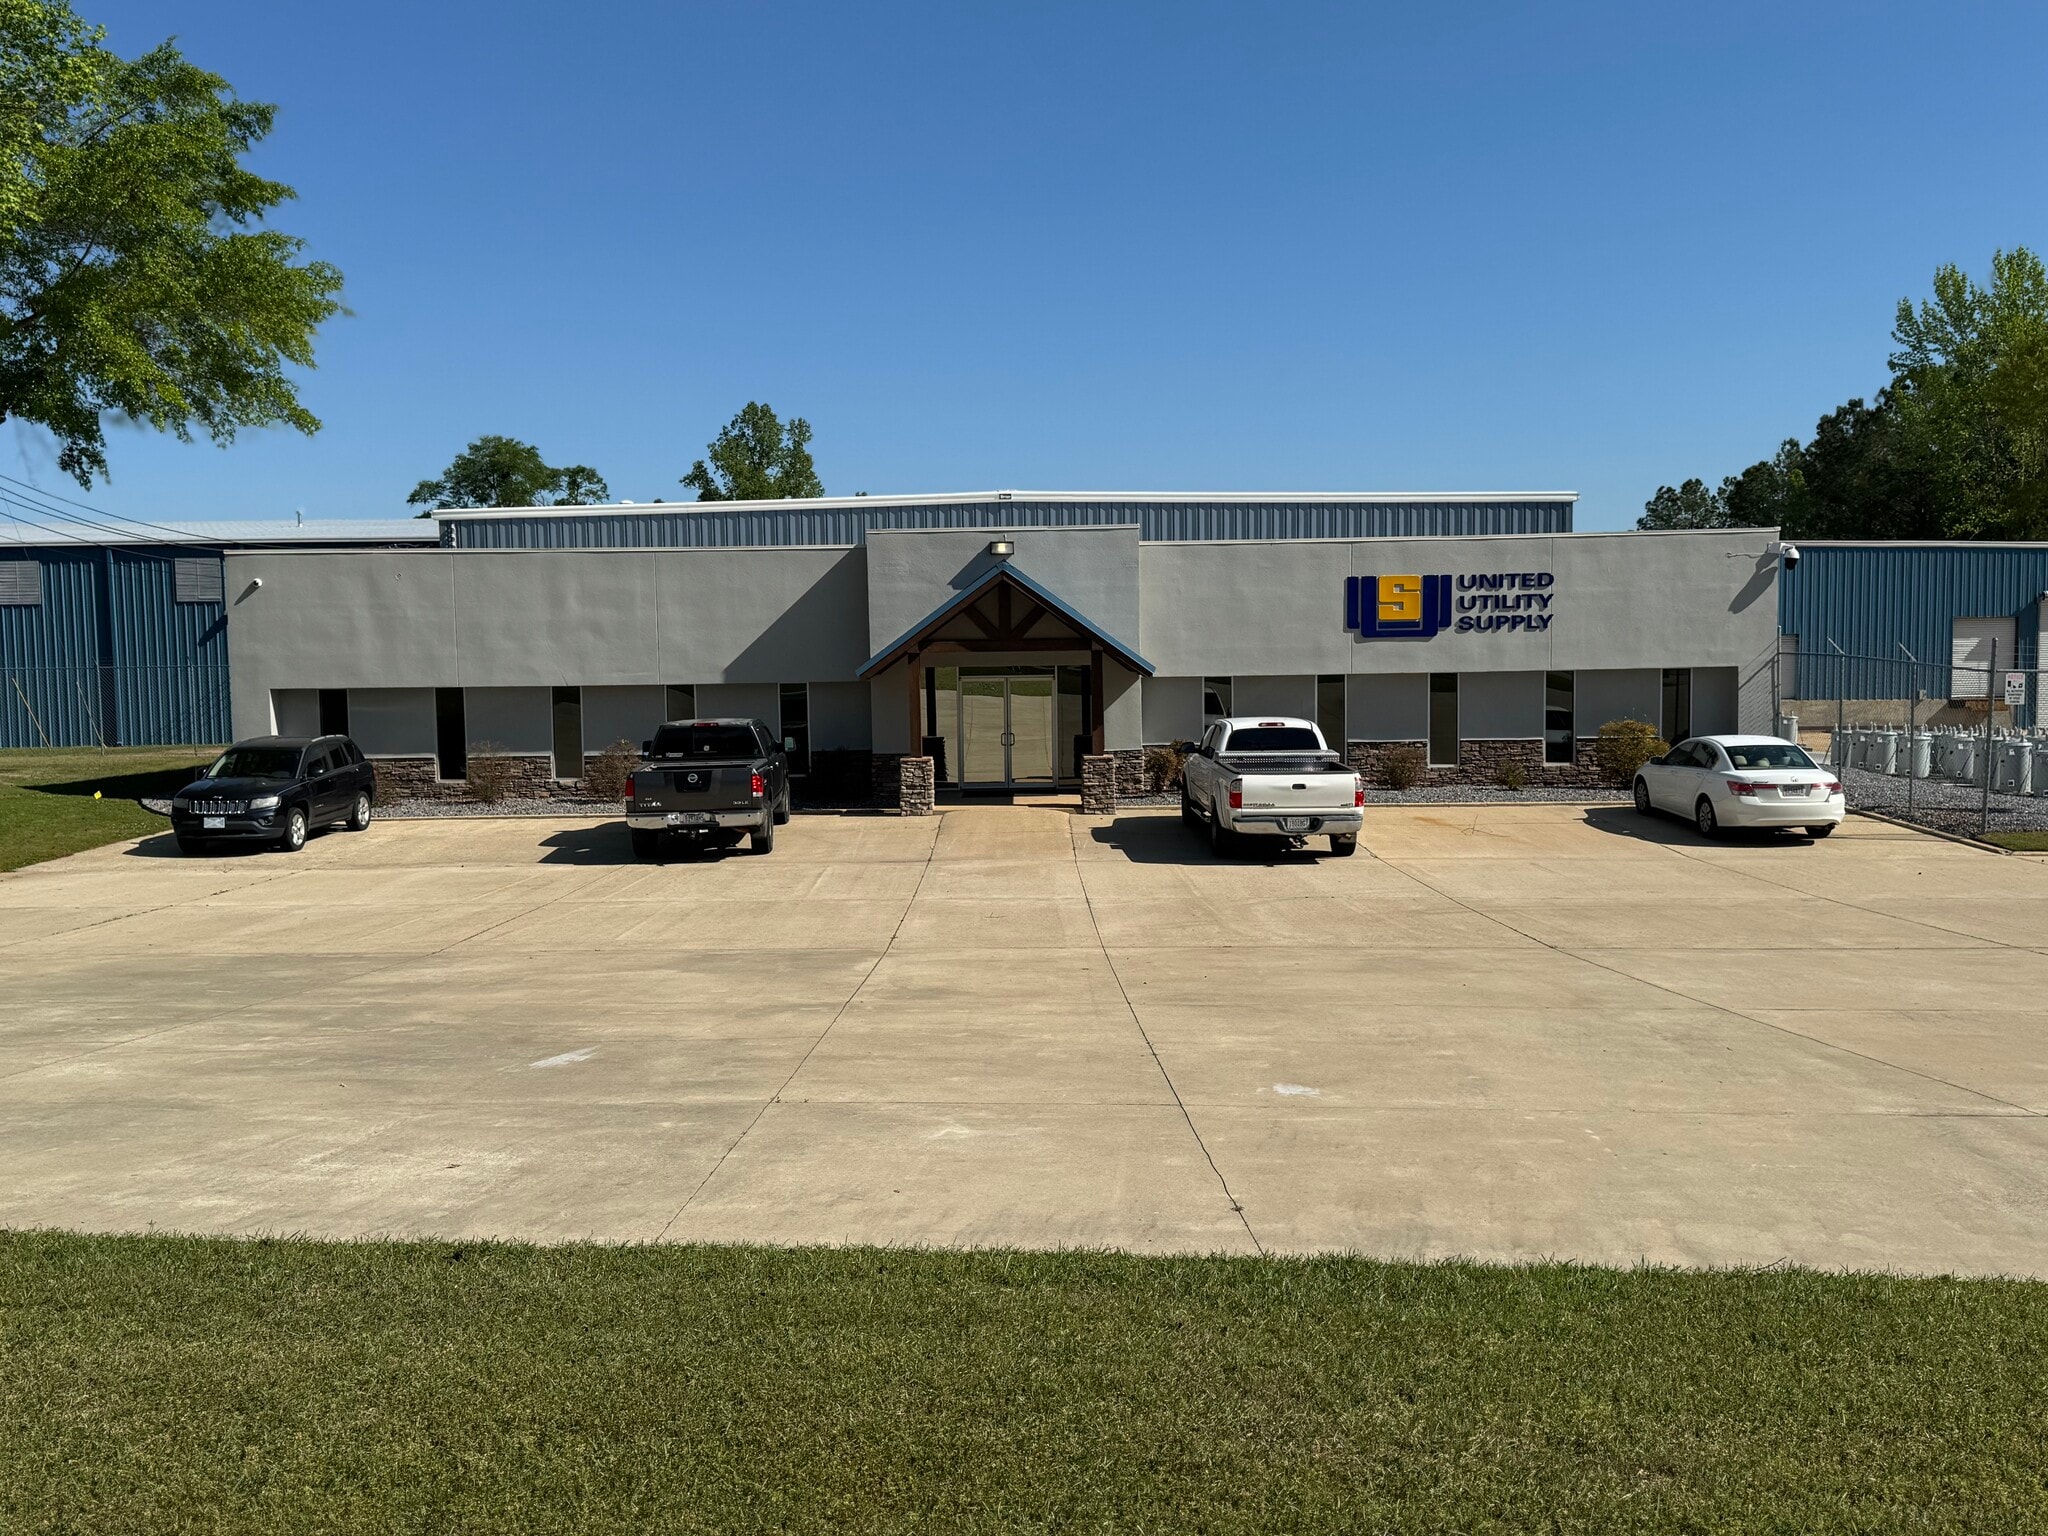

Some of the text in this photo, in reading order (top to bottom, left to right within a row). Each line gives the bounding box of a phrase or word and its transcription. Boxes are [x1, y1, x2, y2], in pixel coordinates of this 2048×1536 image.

[1459, 572, 1555, 589] UNITED
[1459, 593, 1554, 610] UTILITY
[1459, 613, 1554, 631] SUPPLY
